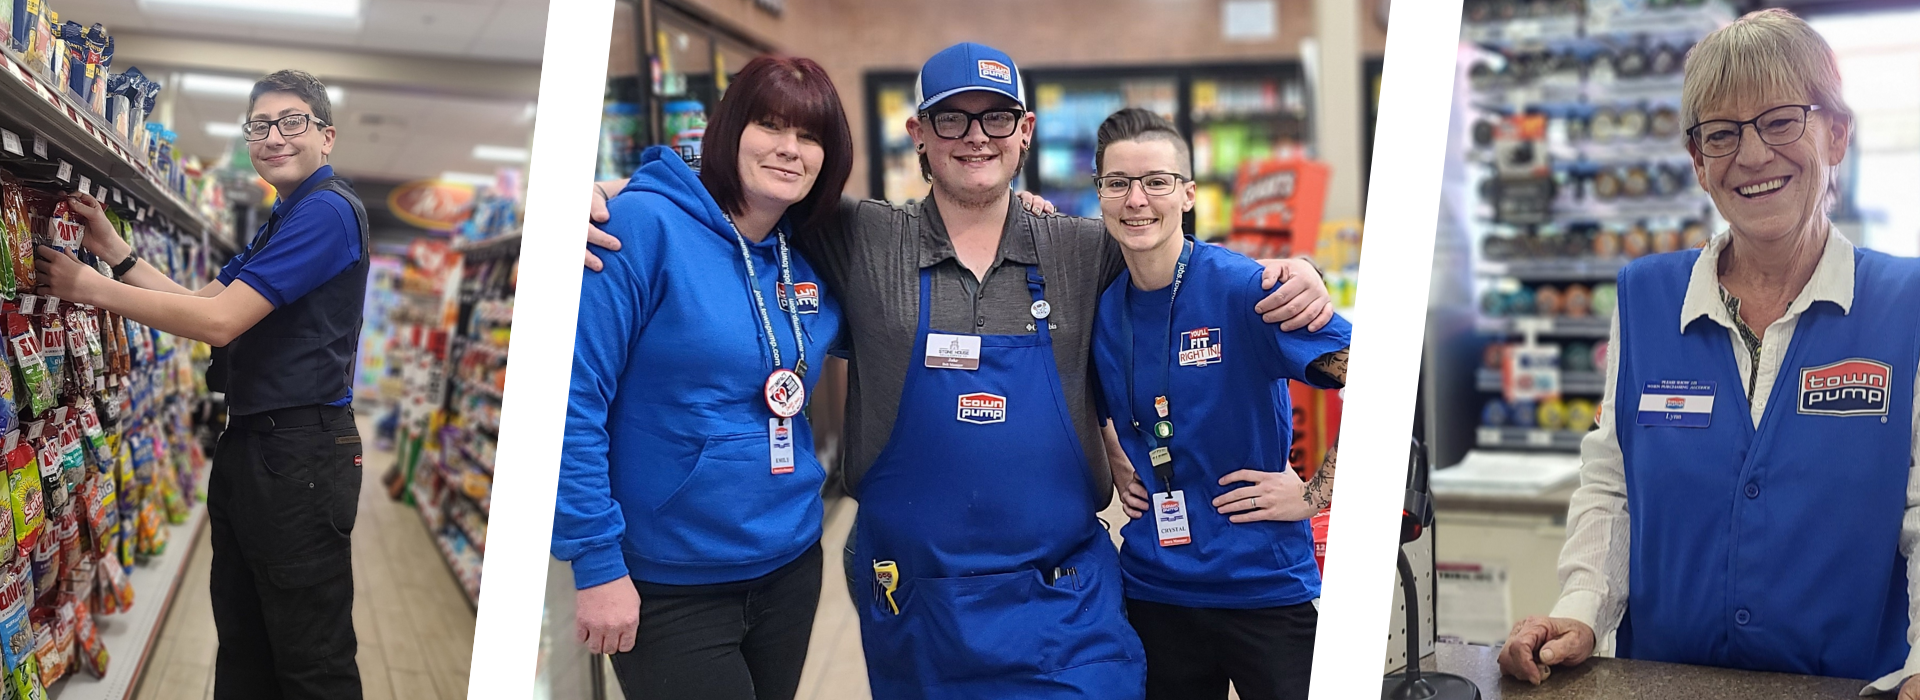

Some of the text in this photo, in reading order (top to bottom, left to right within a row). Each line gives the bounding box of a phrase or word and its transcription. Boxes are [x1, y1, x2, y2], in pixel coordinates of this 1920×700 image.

[982, 70, 1009, 80] pump
[753, 289, 781, 367] jobs.townpump.com
[1190, 328, 1208, 337] YOU'LL
[1191, 338, 1209, 349] FIT
[1180, 349, 1206, 361] RIGHT
[1808, 373, 1884, 389] town
[1808, 388, 1882, 406] pump
[961, 398, 1003, 408] town
[961, 409, 1003, 419] pump
[1665, 413, 1682, 421] Lynn
